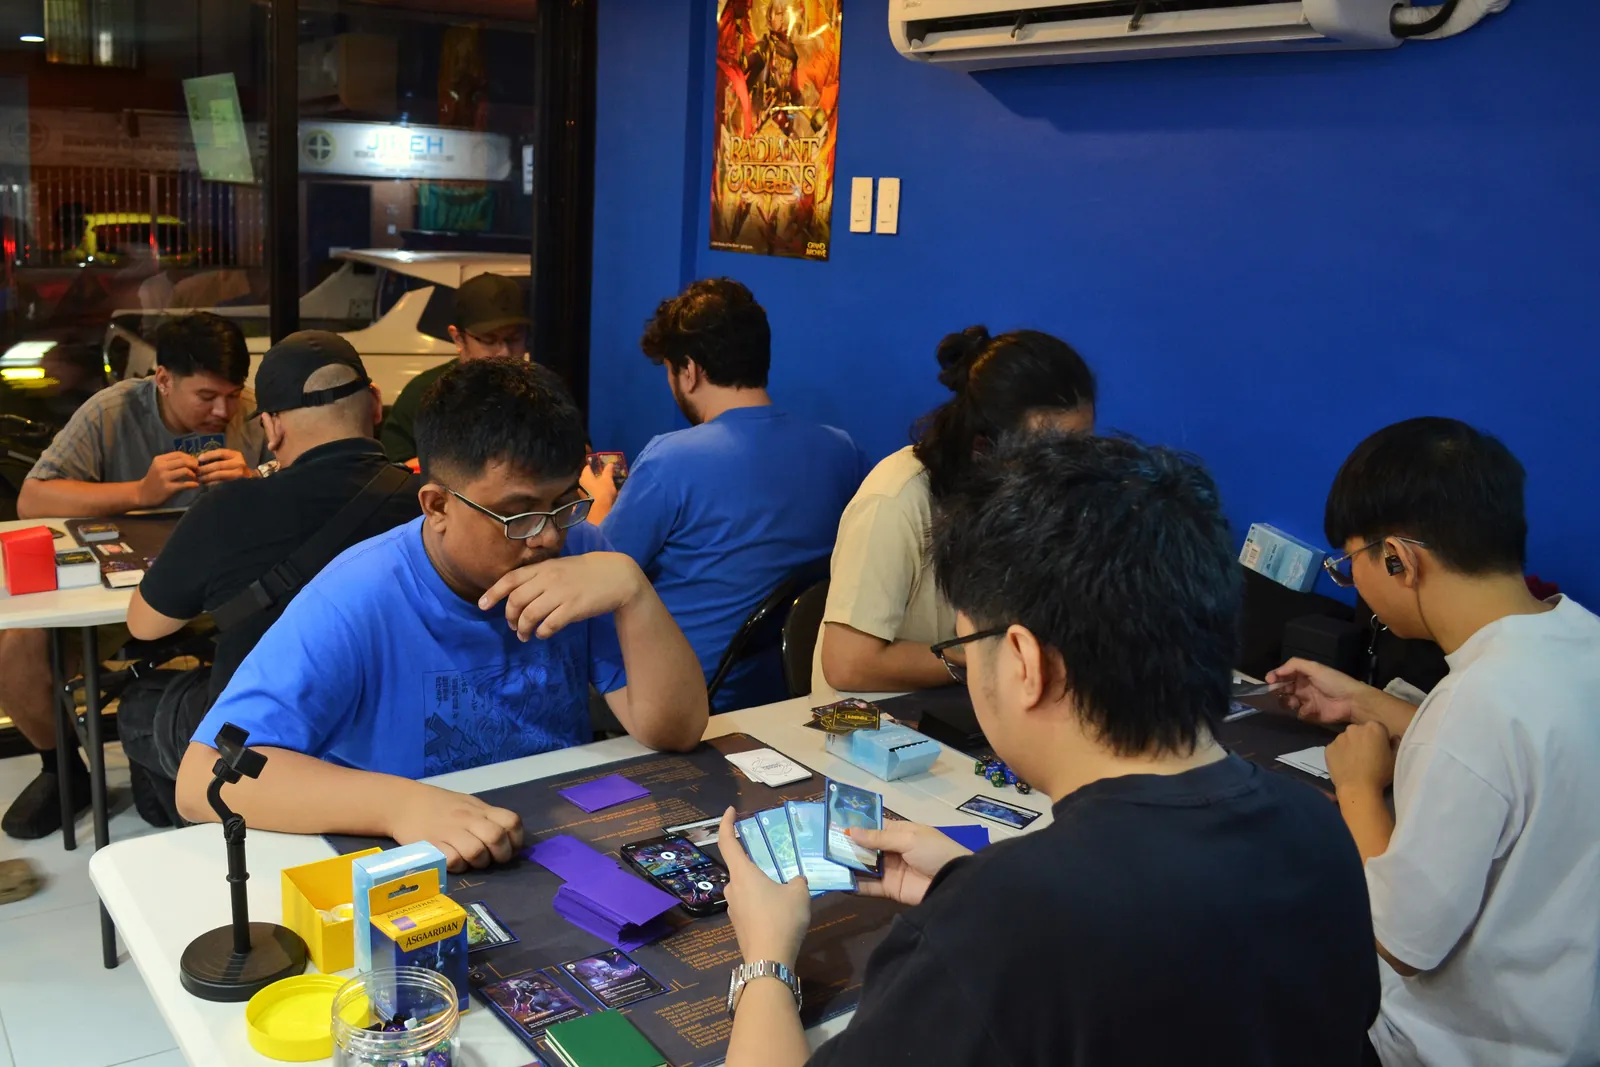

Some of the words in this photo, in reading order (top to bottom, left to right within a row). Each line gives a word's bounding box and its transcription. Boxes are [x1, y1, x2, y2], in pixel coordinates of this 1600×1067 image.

[730, 136, 819, 162] RADIANT
[727, 164, 816, 195] ORIGINS
[405, 921, 459, 949] ASGAARDIAN
